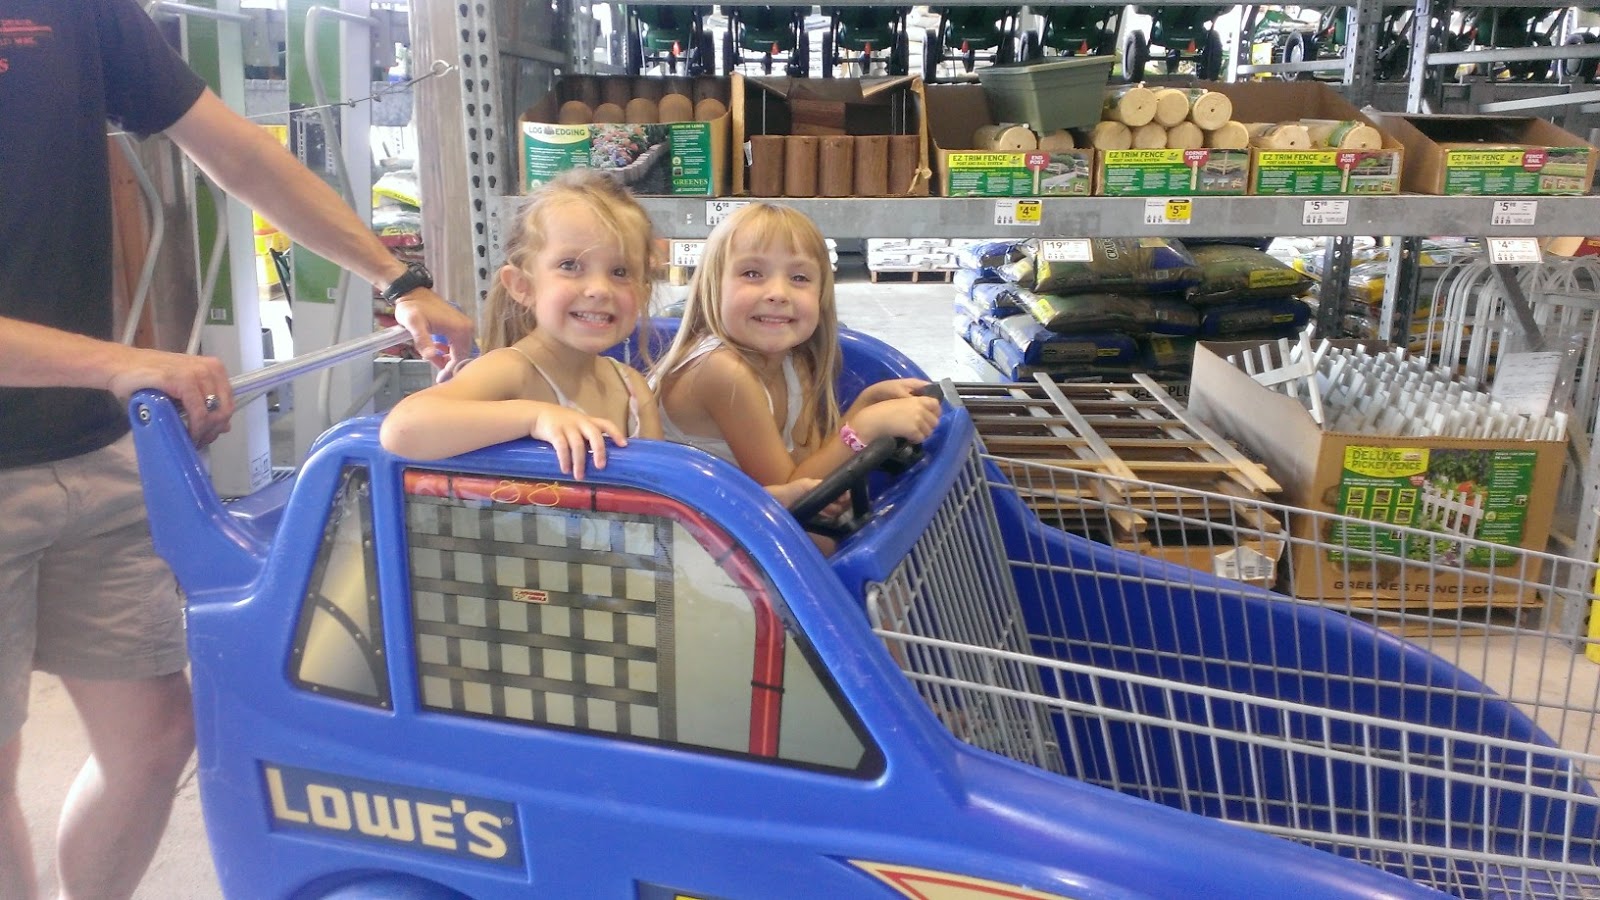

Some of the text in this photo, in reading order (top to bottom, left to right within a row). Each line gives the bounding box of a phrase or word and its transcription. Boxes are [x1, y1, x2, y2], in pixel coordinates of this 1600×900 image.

[528, 126, 586, 136] LOG EDGING
[952, 154, 1007, 162] EZ TRIM FENCE
[672, 178, 708, 186] GREENES
[1103, 236, 1119, 260] CRAB-
[1168, 384, 1190, 397] PLU
[1352, 449, 1401, 461] DELUXE
[1351, 460, 1422, 470] PICKET FENCE
[1333, 580, 1410, 592] GREENES
[1414, 583, 1467, 594] FENCE
[266, 768, 508, 859] LOWE'S
